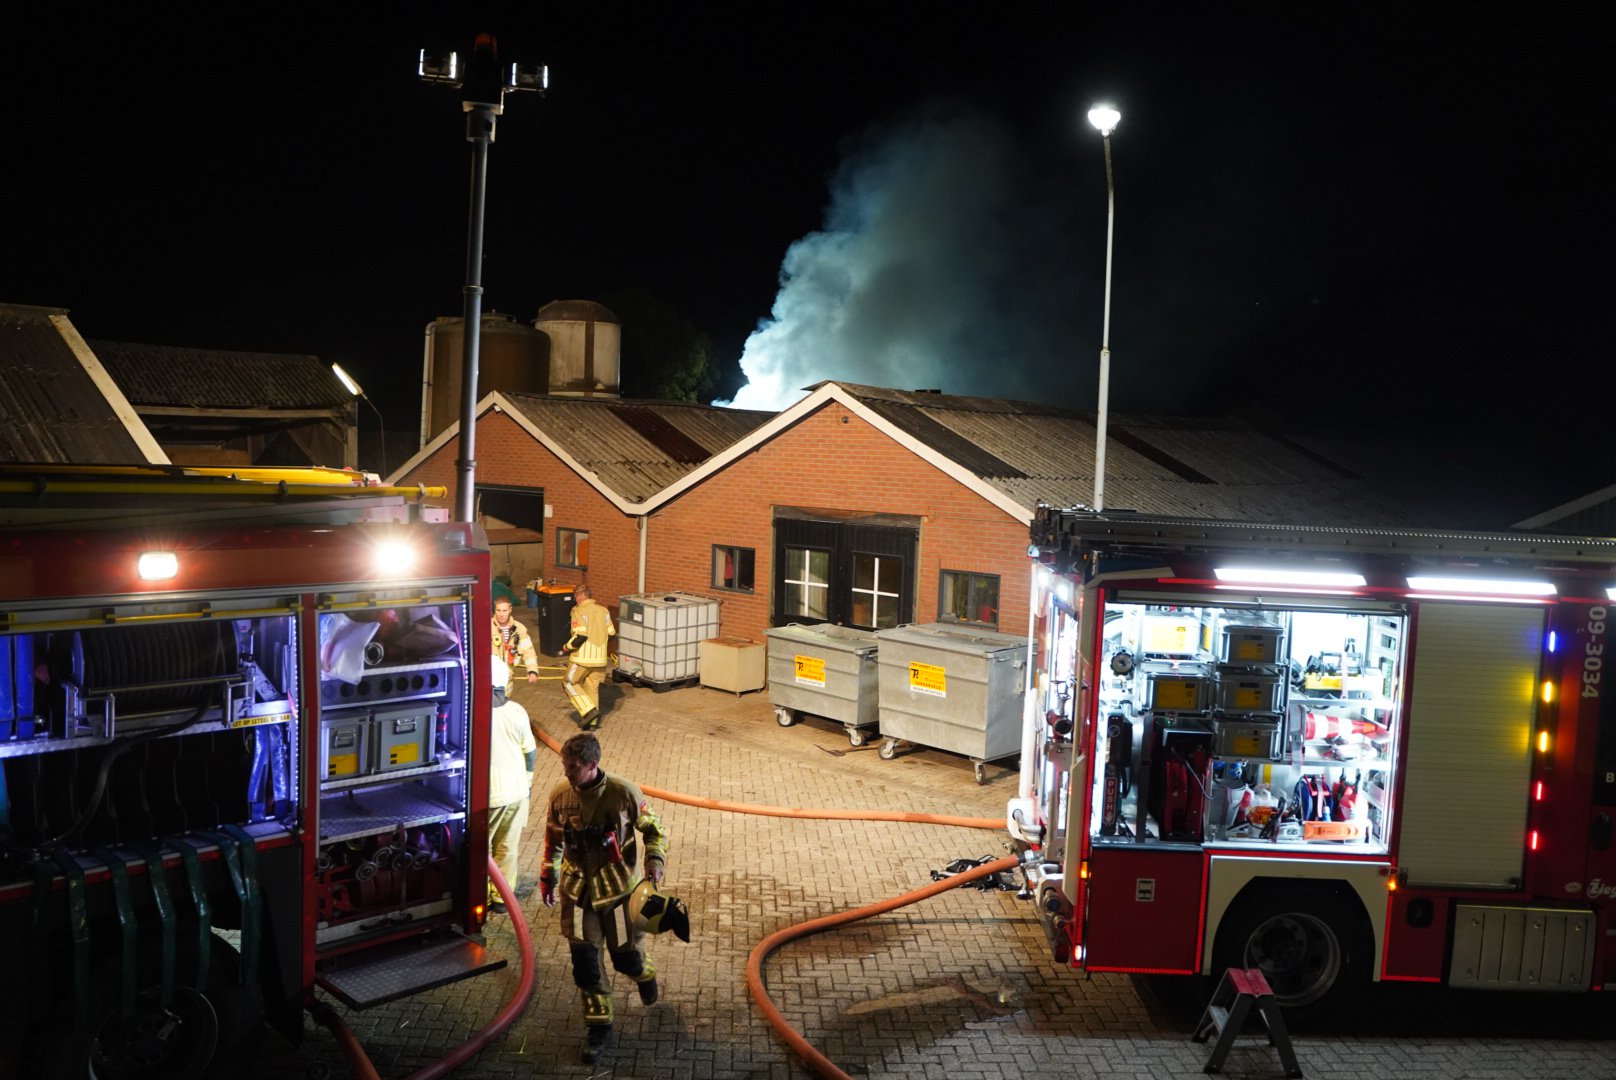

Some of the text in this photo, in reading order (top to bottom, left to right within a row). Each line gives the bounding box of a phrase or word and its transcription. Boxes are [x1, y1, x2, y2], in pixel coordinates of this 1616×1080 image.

[1581, 606, 1607, 698] 09-3034
[232, 720, 241, 728] LET
[1106, 781, 1115, 811] PUSH
